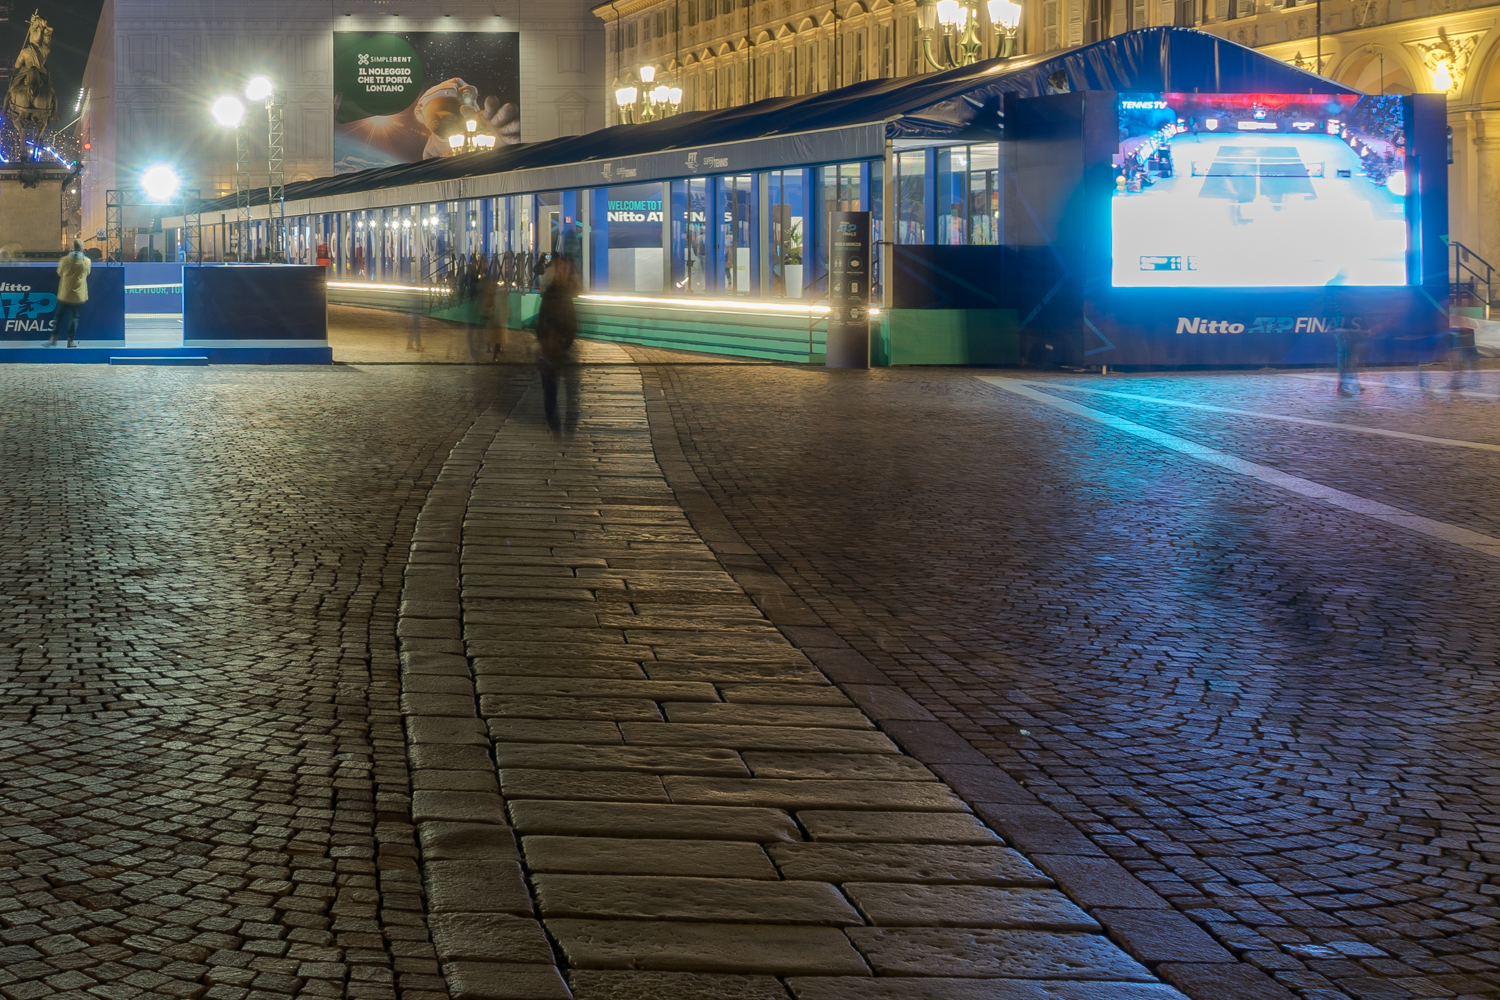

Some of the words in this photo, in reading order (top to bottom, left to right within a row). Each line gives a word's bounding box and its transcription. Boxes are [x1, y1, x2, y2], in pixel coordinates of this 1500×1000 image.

[357, 76, 375, 84] CHE
[385, 76, 413, 84] PORTA
[366, 84, 404, 92] LONTANO
[1122, 101, 1153, 109] TENNIS
[1153, 101, 1167, 109] TV
[607, 200, 646, 211] WELCOME
[646, 200, 656, 210] TO
[606, 211, 646, 222] Nitto
[4, 319, 58, 332] FINALS
[1176, 317, 1245, 334] Nitto
[1246, 317, 1295, 334] ATP
[1295, 317, 1362, 334] FINALS
